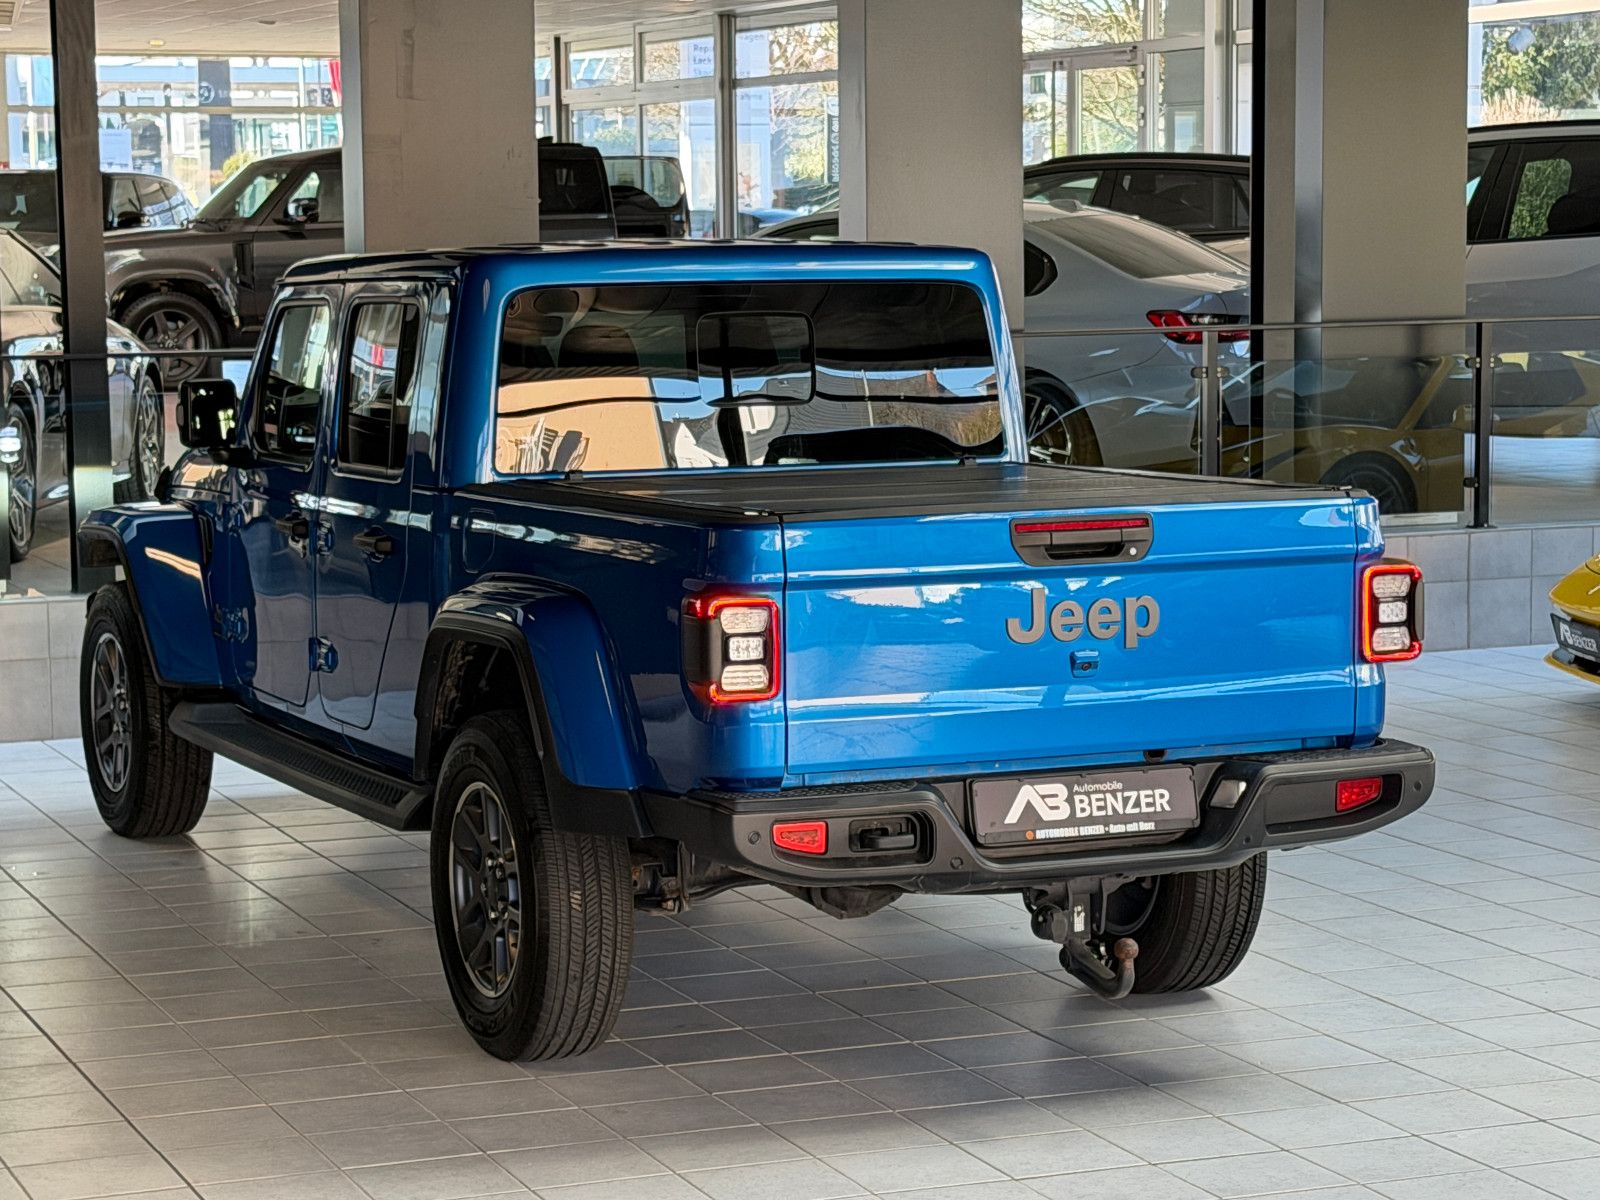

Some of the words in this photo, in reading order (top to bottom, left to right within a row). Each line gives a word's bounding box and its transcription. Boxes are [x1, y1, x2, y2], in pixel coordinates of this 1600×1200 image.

[1006, 588, 1160, 649] Jeep
[1073, 780, 1123, 793] Automobile
[1004, 783, 1071, 824] AB
[1073, 788, 1171, 818] BENZER
[1036, 826, 1079, 839] AUTOMOBILE
